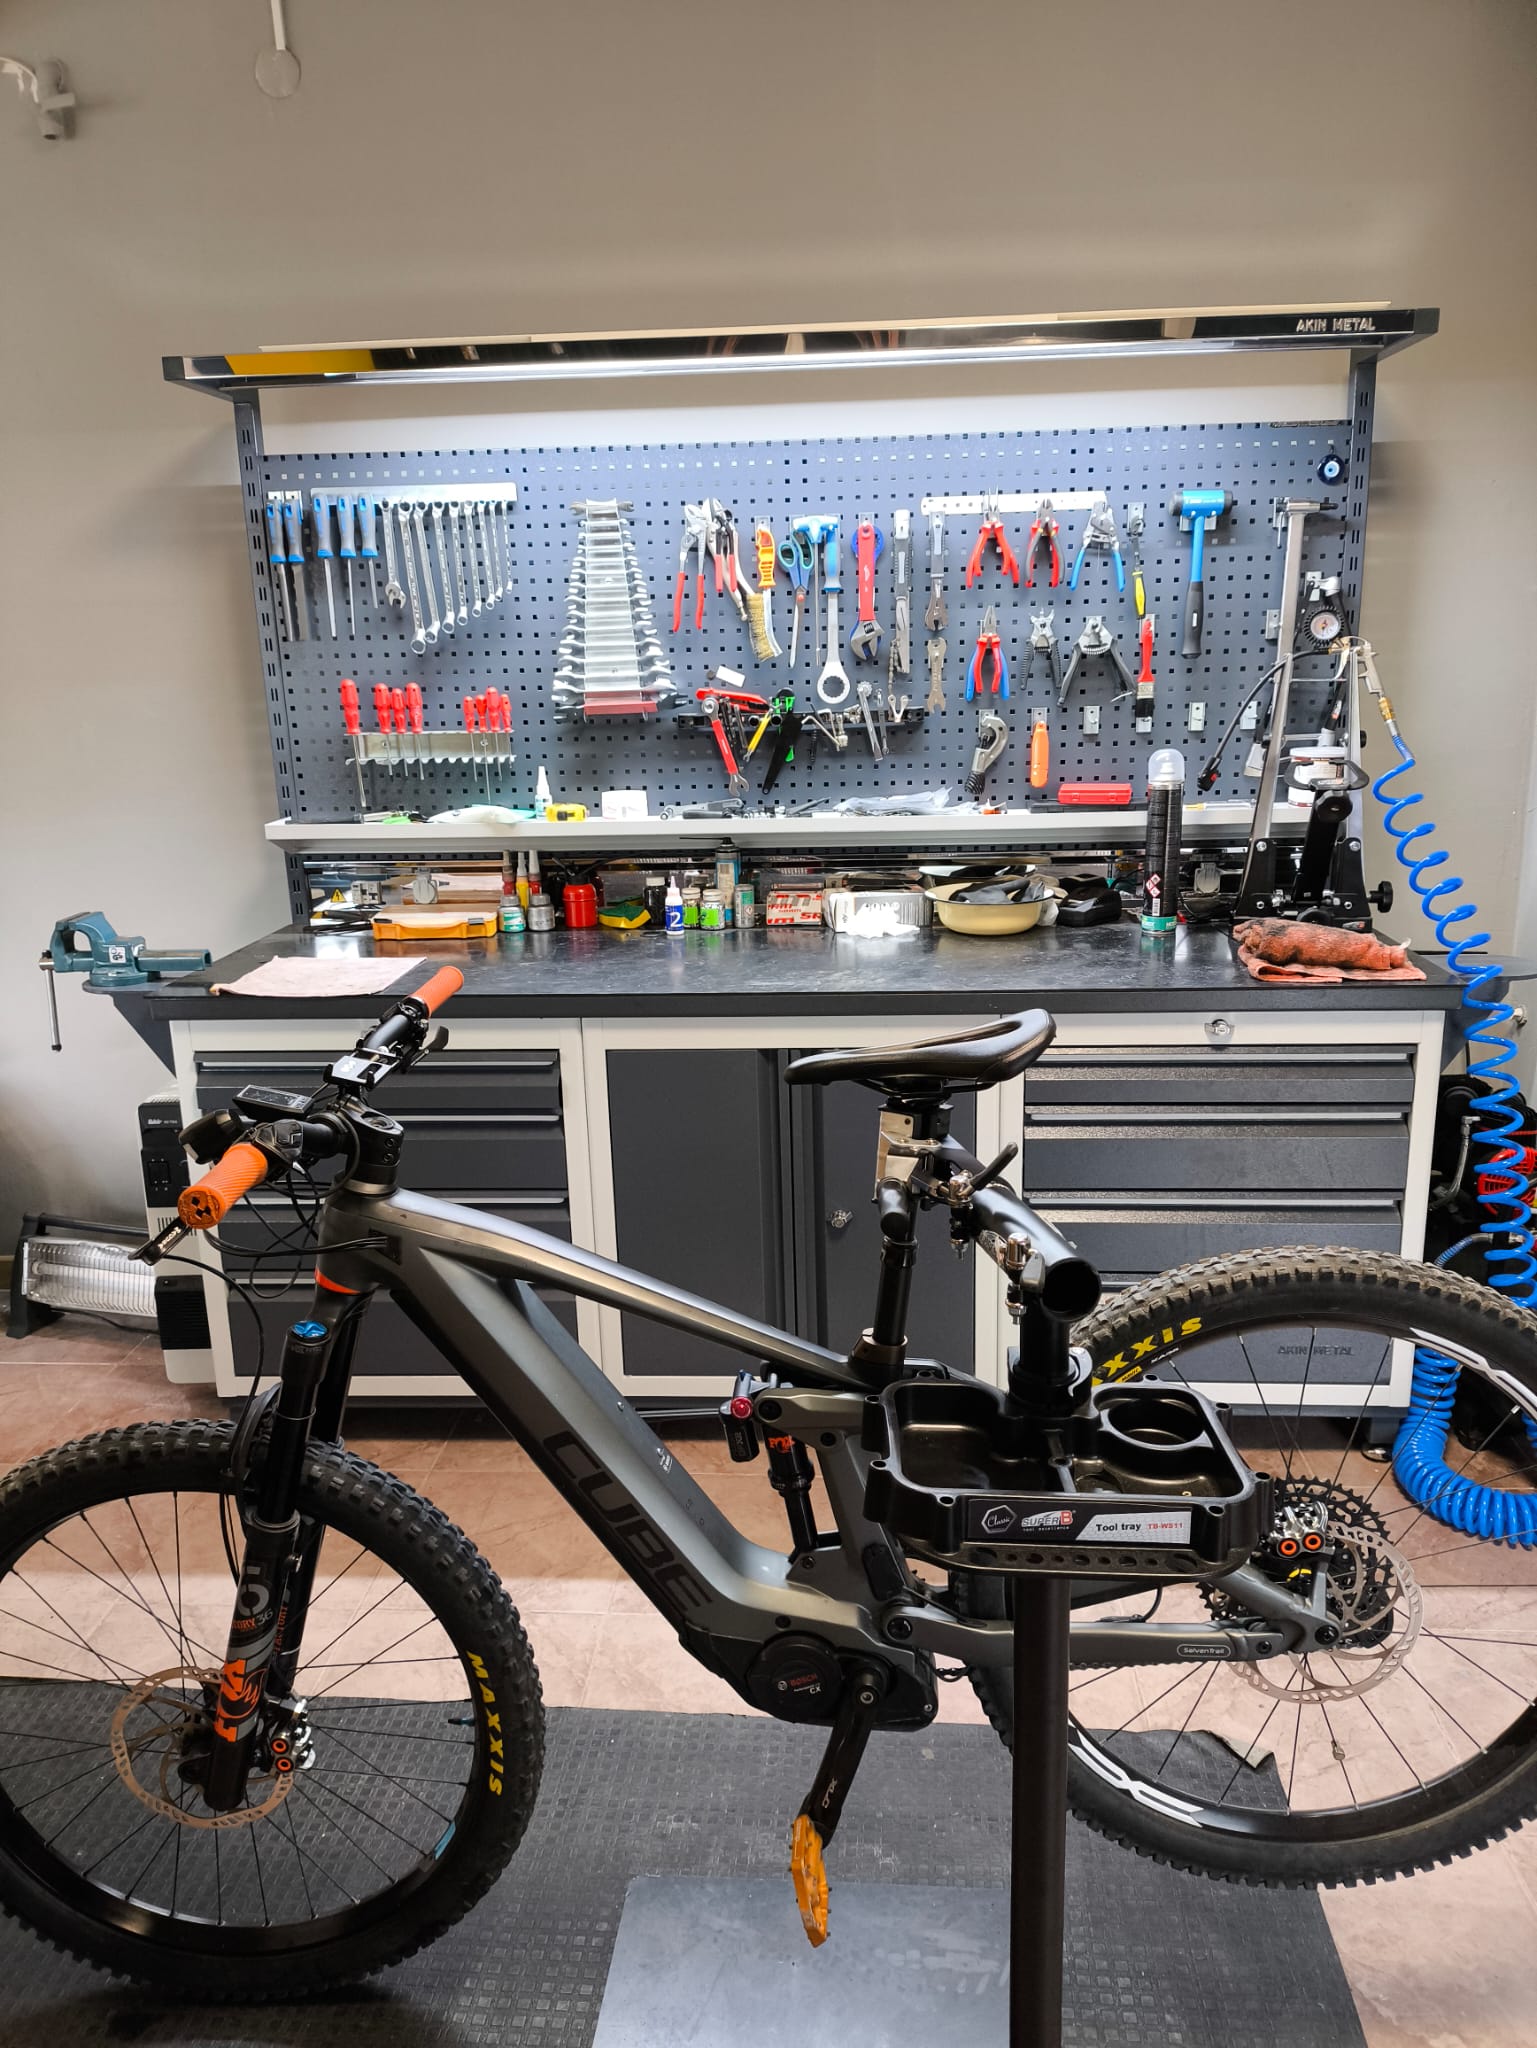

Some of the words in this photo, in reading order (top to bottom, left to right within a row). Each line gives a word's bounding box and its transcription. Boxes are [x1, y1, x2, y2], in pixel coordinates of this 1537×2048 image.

[1296, 319, 1327, 332] AKIN
[1332, 317, 1376, 331] METAL
[669, 911, 682, 928] 2
[1092, 1317, 1202, 1386] XXIS
[1278, 1345, 1308, 1355] AKIN
[1313, 1345, 1355, 1356] METAL
[543, 1431, 713, 1611] CUBE
[1022, 1517, 1060, 1526] SUPER
[1096, 1523, 1118, 1532] Tool
[1121, 1522, 1141, 1531] tray
[256, 1609, 274, 1625] 36
[809, 1686, 821, 1694] CX
[466, 1650, 504, 1796] MAXXIS
